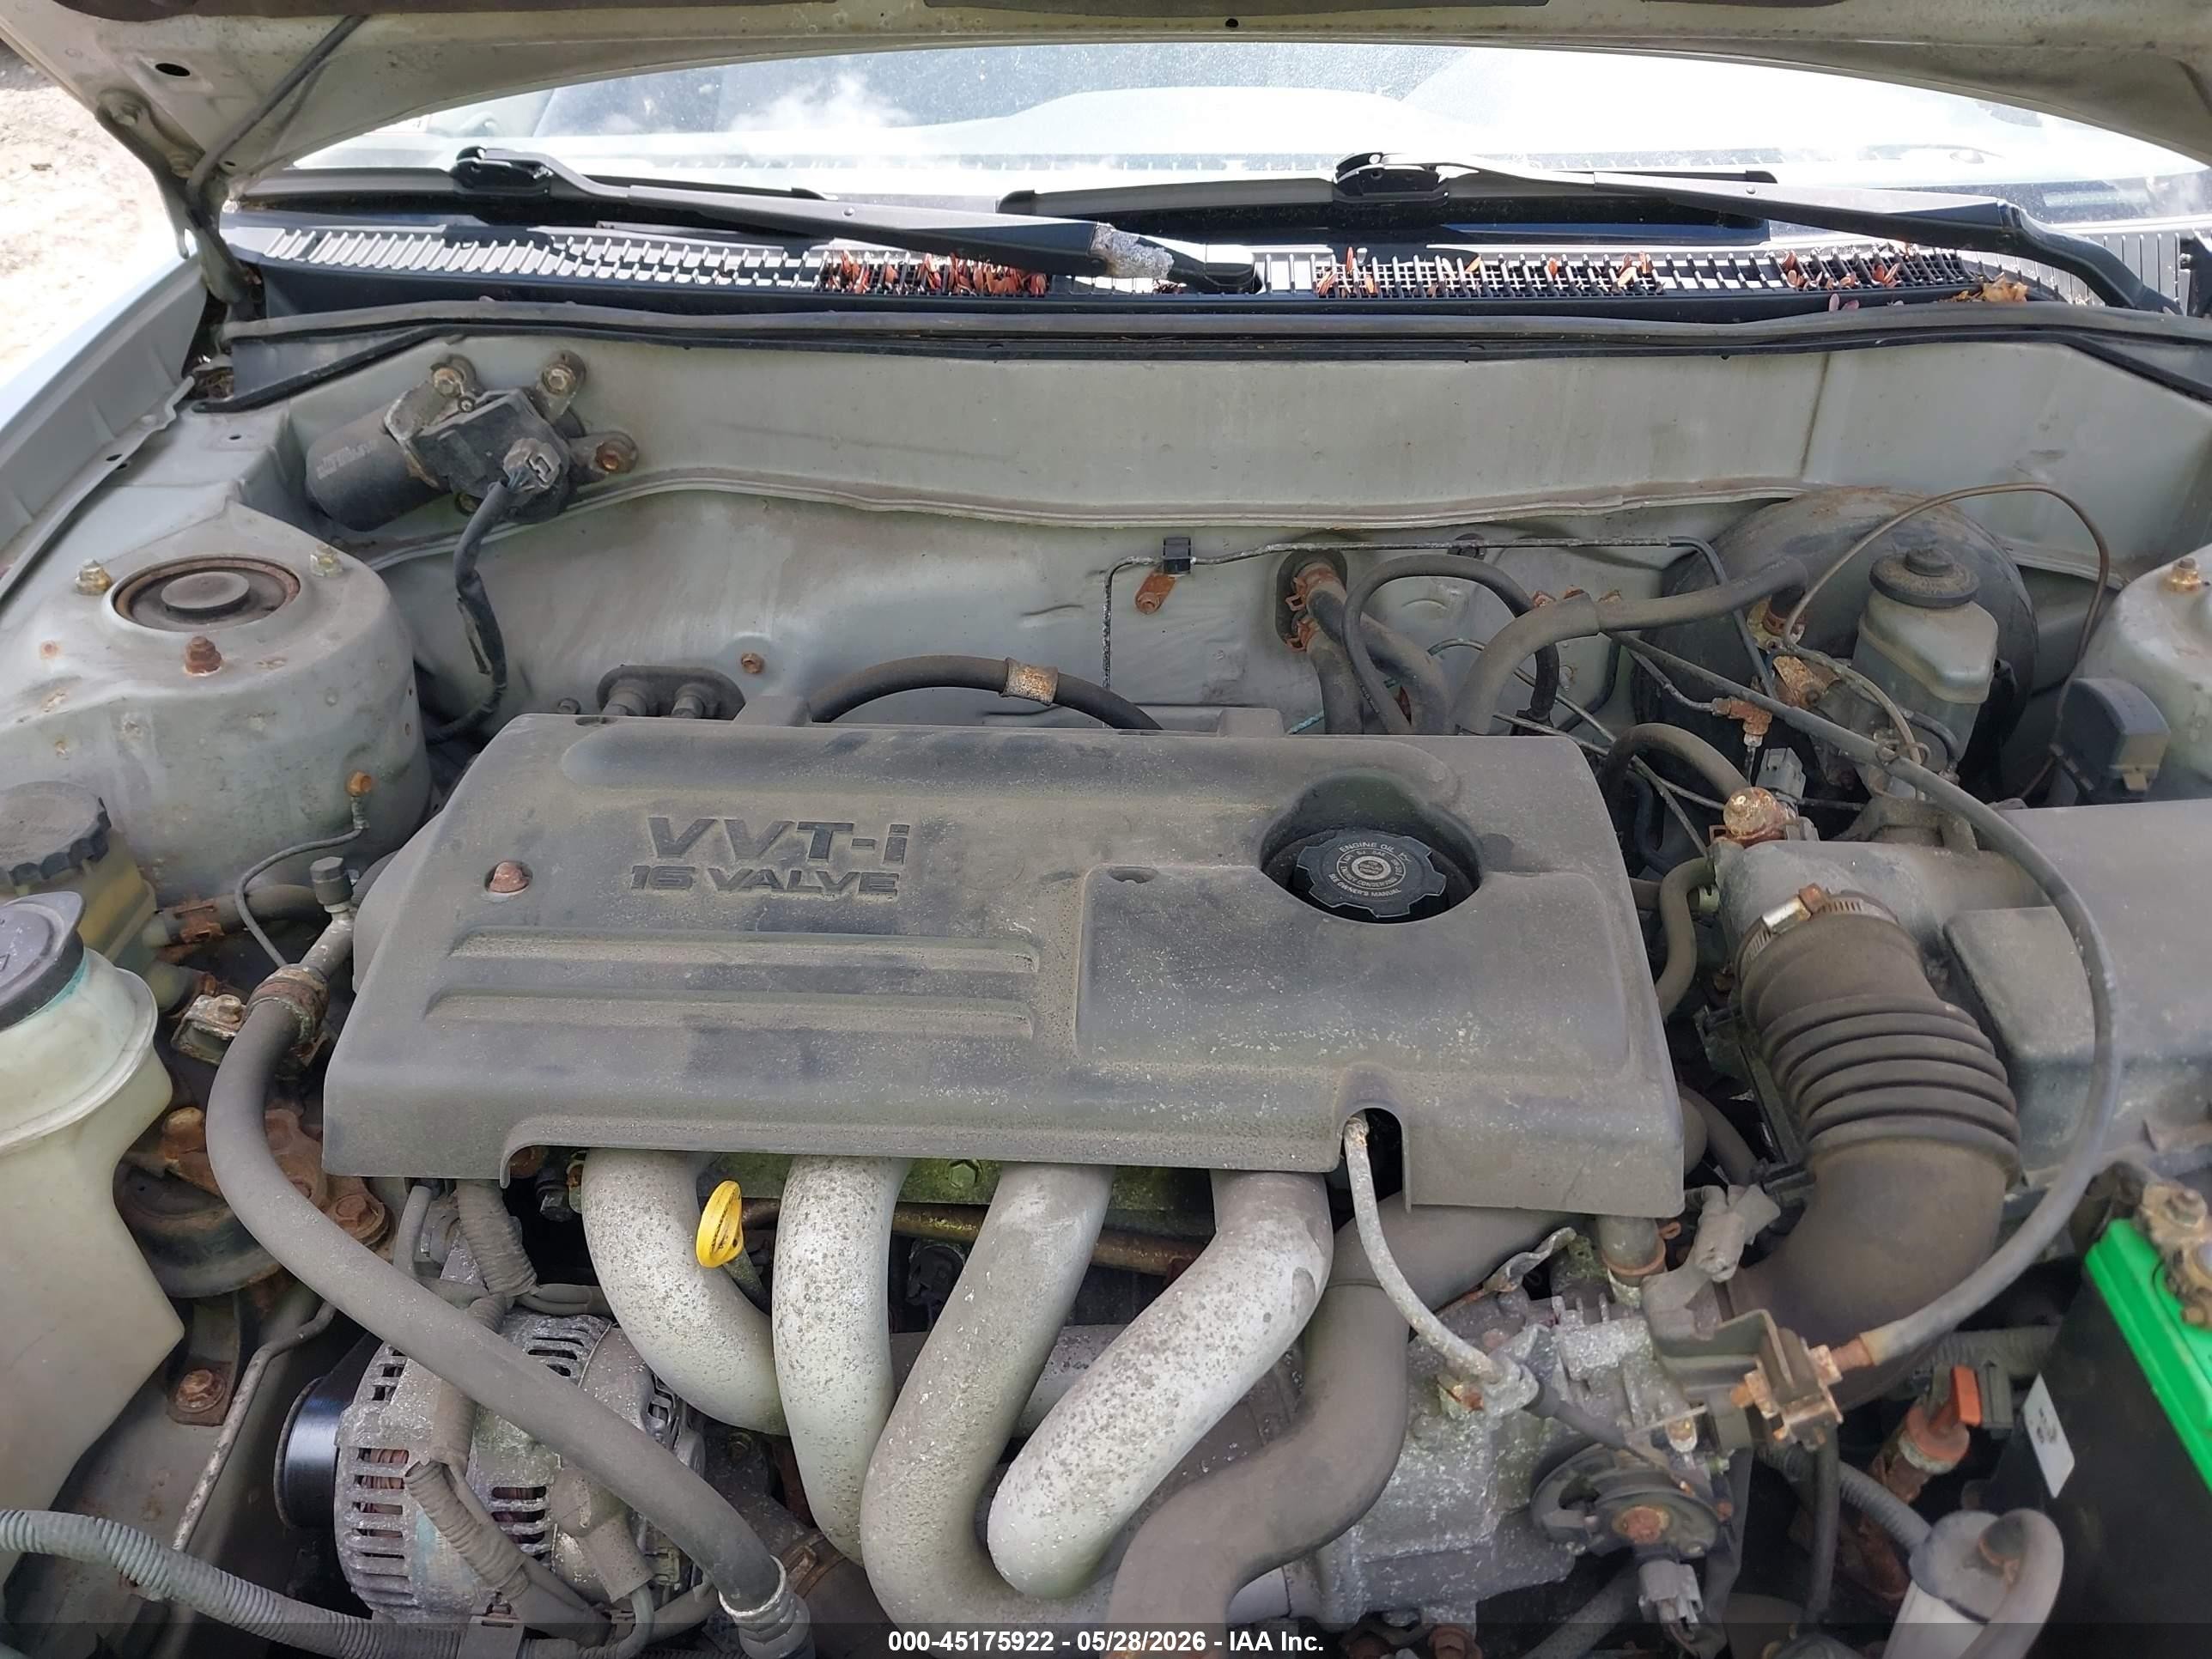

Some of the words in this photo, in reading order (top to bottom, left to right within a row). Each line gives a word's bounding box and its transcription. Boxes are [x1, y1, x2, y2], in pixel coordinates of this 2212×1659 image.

[647, 817, 910, 864] VVT-i
[1339, 841, 1378, 854] ENGINE
[1380, 843, 1395, 854] OIL
[631, 865, 696, 890] 16
[708, 866, 900, 895] VALVE
[1328, 872, 1339, 884] SEE
[1336, 881, 1370, 896] OWNER'S
[1370, 888, 1402, 897] MANUAL
